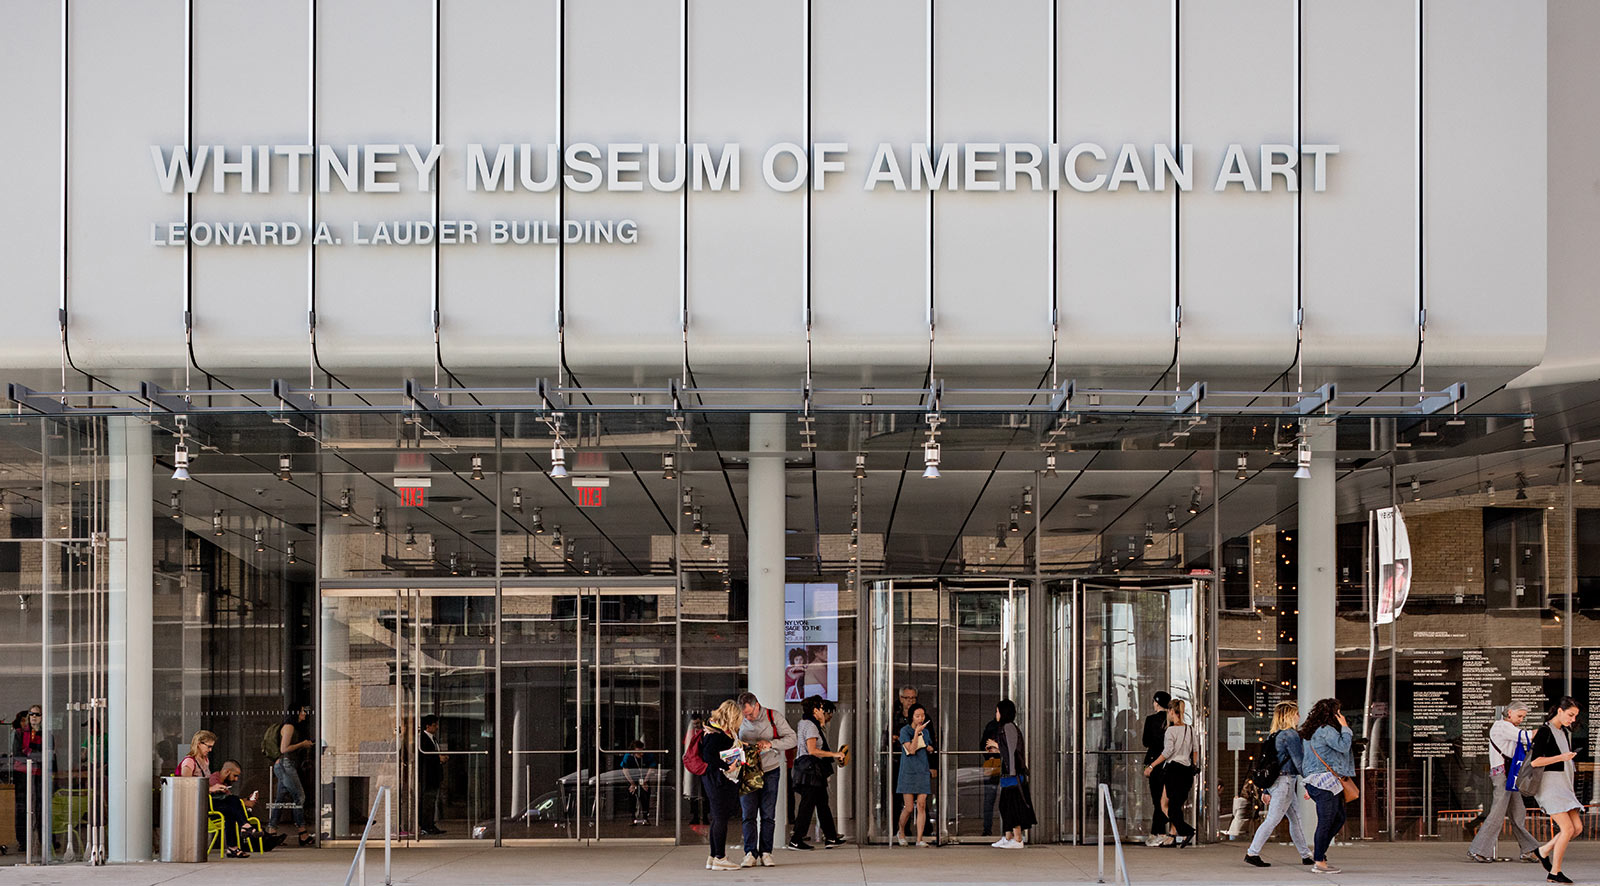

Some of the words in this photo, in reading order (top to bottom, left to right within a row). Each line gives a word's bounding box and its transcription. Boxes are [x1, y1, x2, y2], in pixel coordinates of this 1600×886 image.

[150, 143, 444, 193] WHITNEY
[467, 142, 740, 192] MUSEUM
[762, 142, 848, 192] OF
[864, 142, 1194, 192] AMERICAN
[1213, 142, 1340, 192] ART
[150, 221, 301, 247] LEONARD
[313, 221, 342, 246] A.
[353, 220, 478, 245] LAUDER
[490, 219, 638, 245] BUILDING
